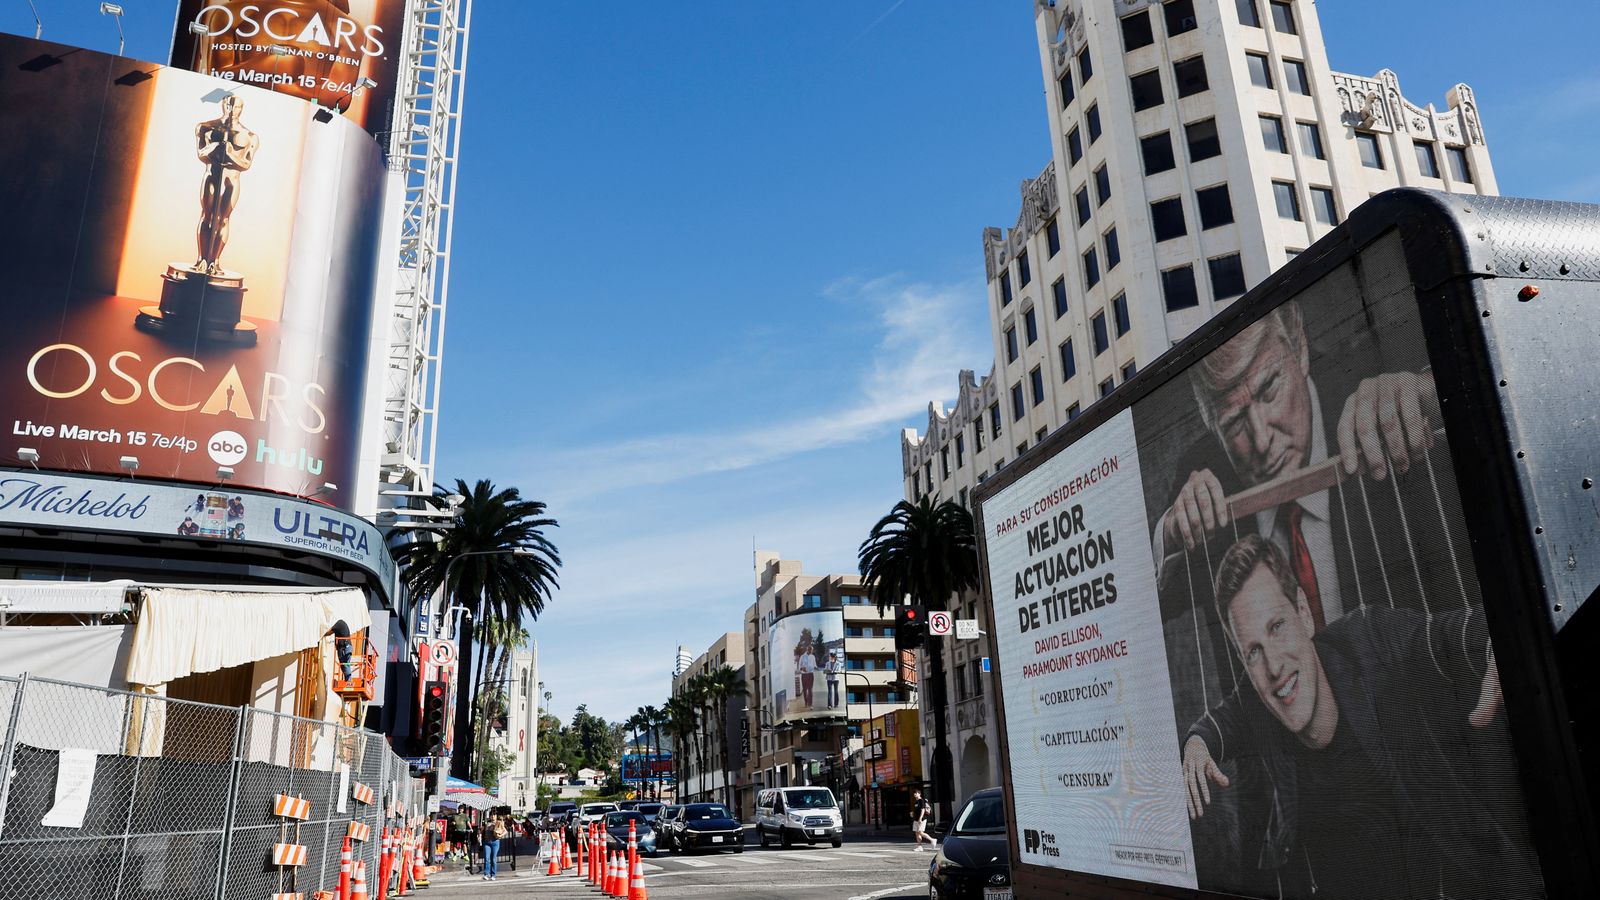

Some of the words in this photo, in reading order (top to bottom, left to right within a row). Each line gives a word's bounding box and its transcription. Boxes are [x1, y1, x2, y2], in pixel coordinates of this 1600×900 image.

[195, 5, 384, 57] OSCARS
[211, 43, 252, 51] HOSTED
[256, 44, 268, 53] BY
[316, 51, 360, 67] O'BRIEN
[211, 67, 235, 80] ive
[239, 68, 293, 85] March
[298, 74, 316, 88] 15
[320, 77, 363, 98] 7e/4p
[26, 343, 327, 435] OSCARS
[13, 420, 55, 438] Live
[59, 424, 121, 444] March
[126, 430, 147, 446] 15
[151, 433, 198, 454] 7e/4p
[210, 439, 245, 456] abc
[255, 438, 324, 476] hulu
[0, 478, 150, 519] Michelob
[996, 515, 1018, 537] PARA
[1020, 509, 1032, 524] SU
[1034, 455, 1119, 518] CONSIDERACIÓN
[273, 507, 370, 556] ULTRA
[284, 535, 328, 550] SUPERIOR
[329, 544, 349, 556] LIGHT
[350, 551, 364, 561] BEER
[1026, 503, 1086, 557] MEJOR
[1014, 530, 1115, 600] ACTUACIÓN
[1018, 601, 1041, 634] DE
[1042, 572, 1118, 625] TÍTERES
[1034, 631, 1060, 655] DAVID
[1061, 622, 1103, 648] ELLISON,
[1022, 653, 1074, 679] PARAMOUNT
[1075, 640, 1128, 667] SKYDANCE
[1041, 830, 1055, 844] Free
[1042, 843, 1060, 857] Press
